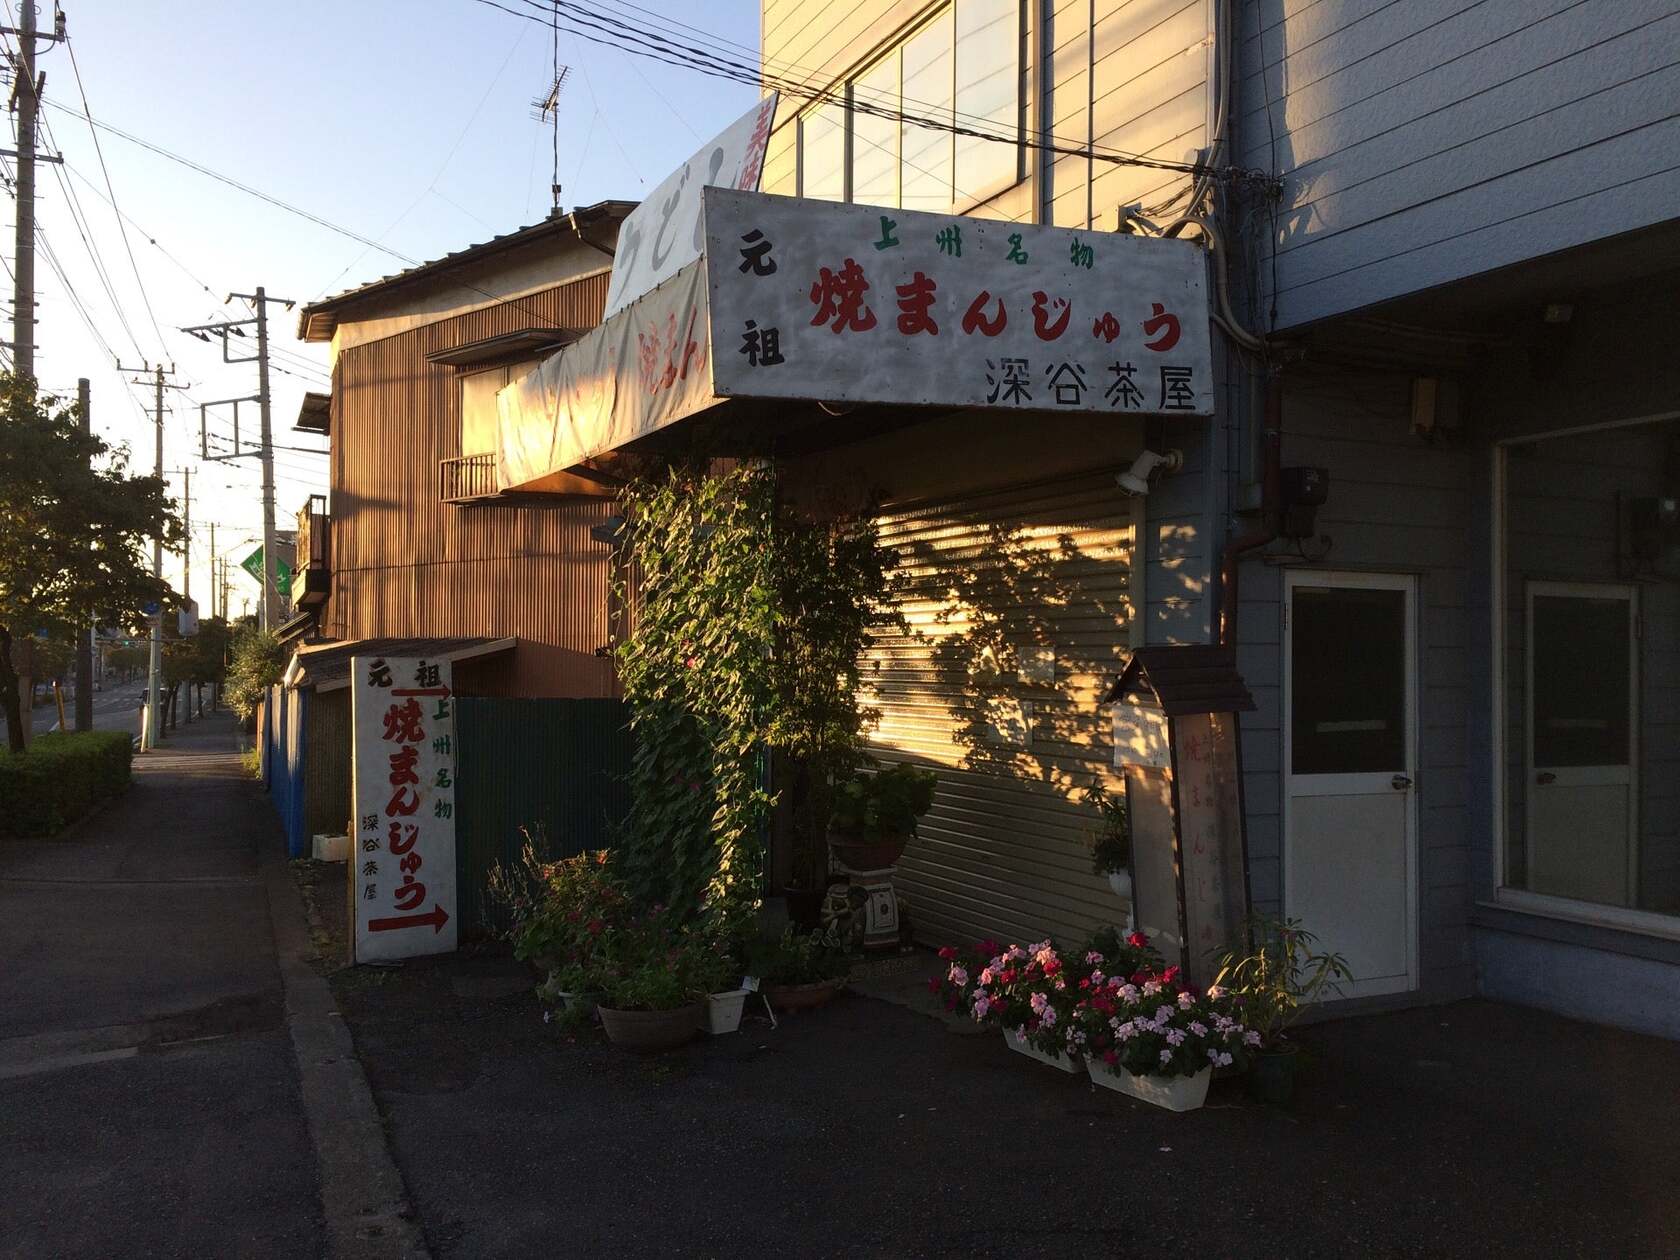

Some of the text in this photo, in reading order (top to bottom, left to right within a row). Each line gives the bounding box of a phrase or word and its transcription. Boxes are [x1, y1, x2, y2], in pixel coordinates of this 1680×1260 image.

[873, 215, 1095, 271] 上州名物
[738, 228, 786, 367] 元祖
[810, 257, 1182, 353] 焼まんじゅう
[985, 357, 1197, 413] 深谷茶屋
[367, 658, 441, 689] 元祖
[382, 697, 426, 911] 焼まんじゅう
[432, 698, 453, 819] 上州名物
[362, 813, 381, 900] 深谷茶屋
